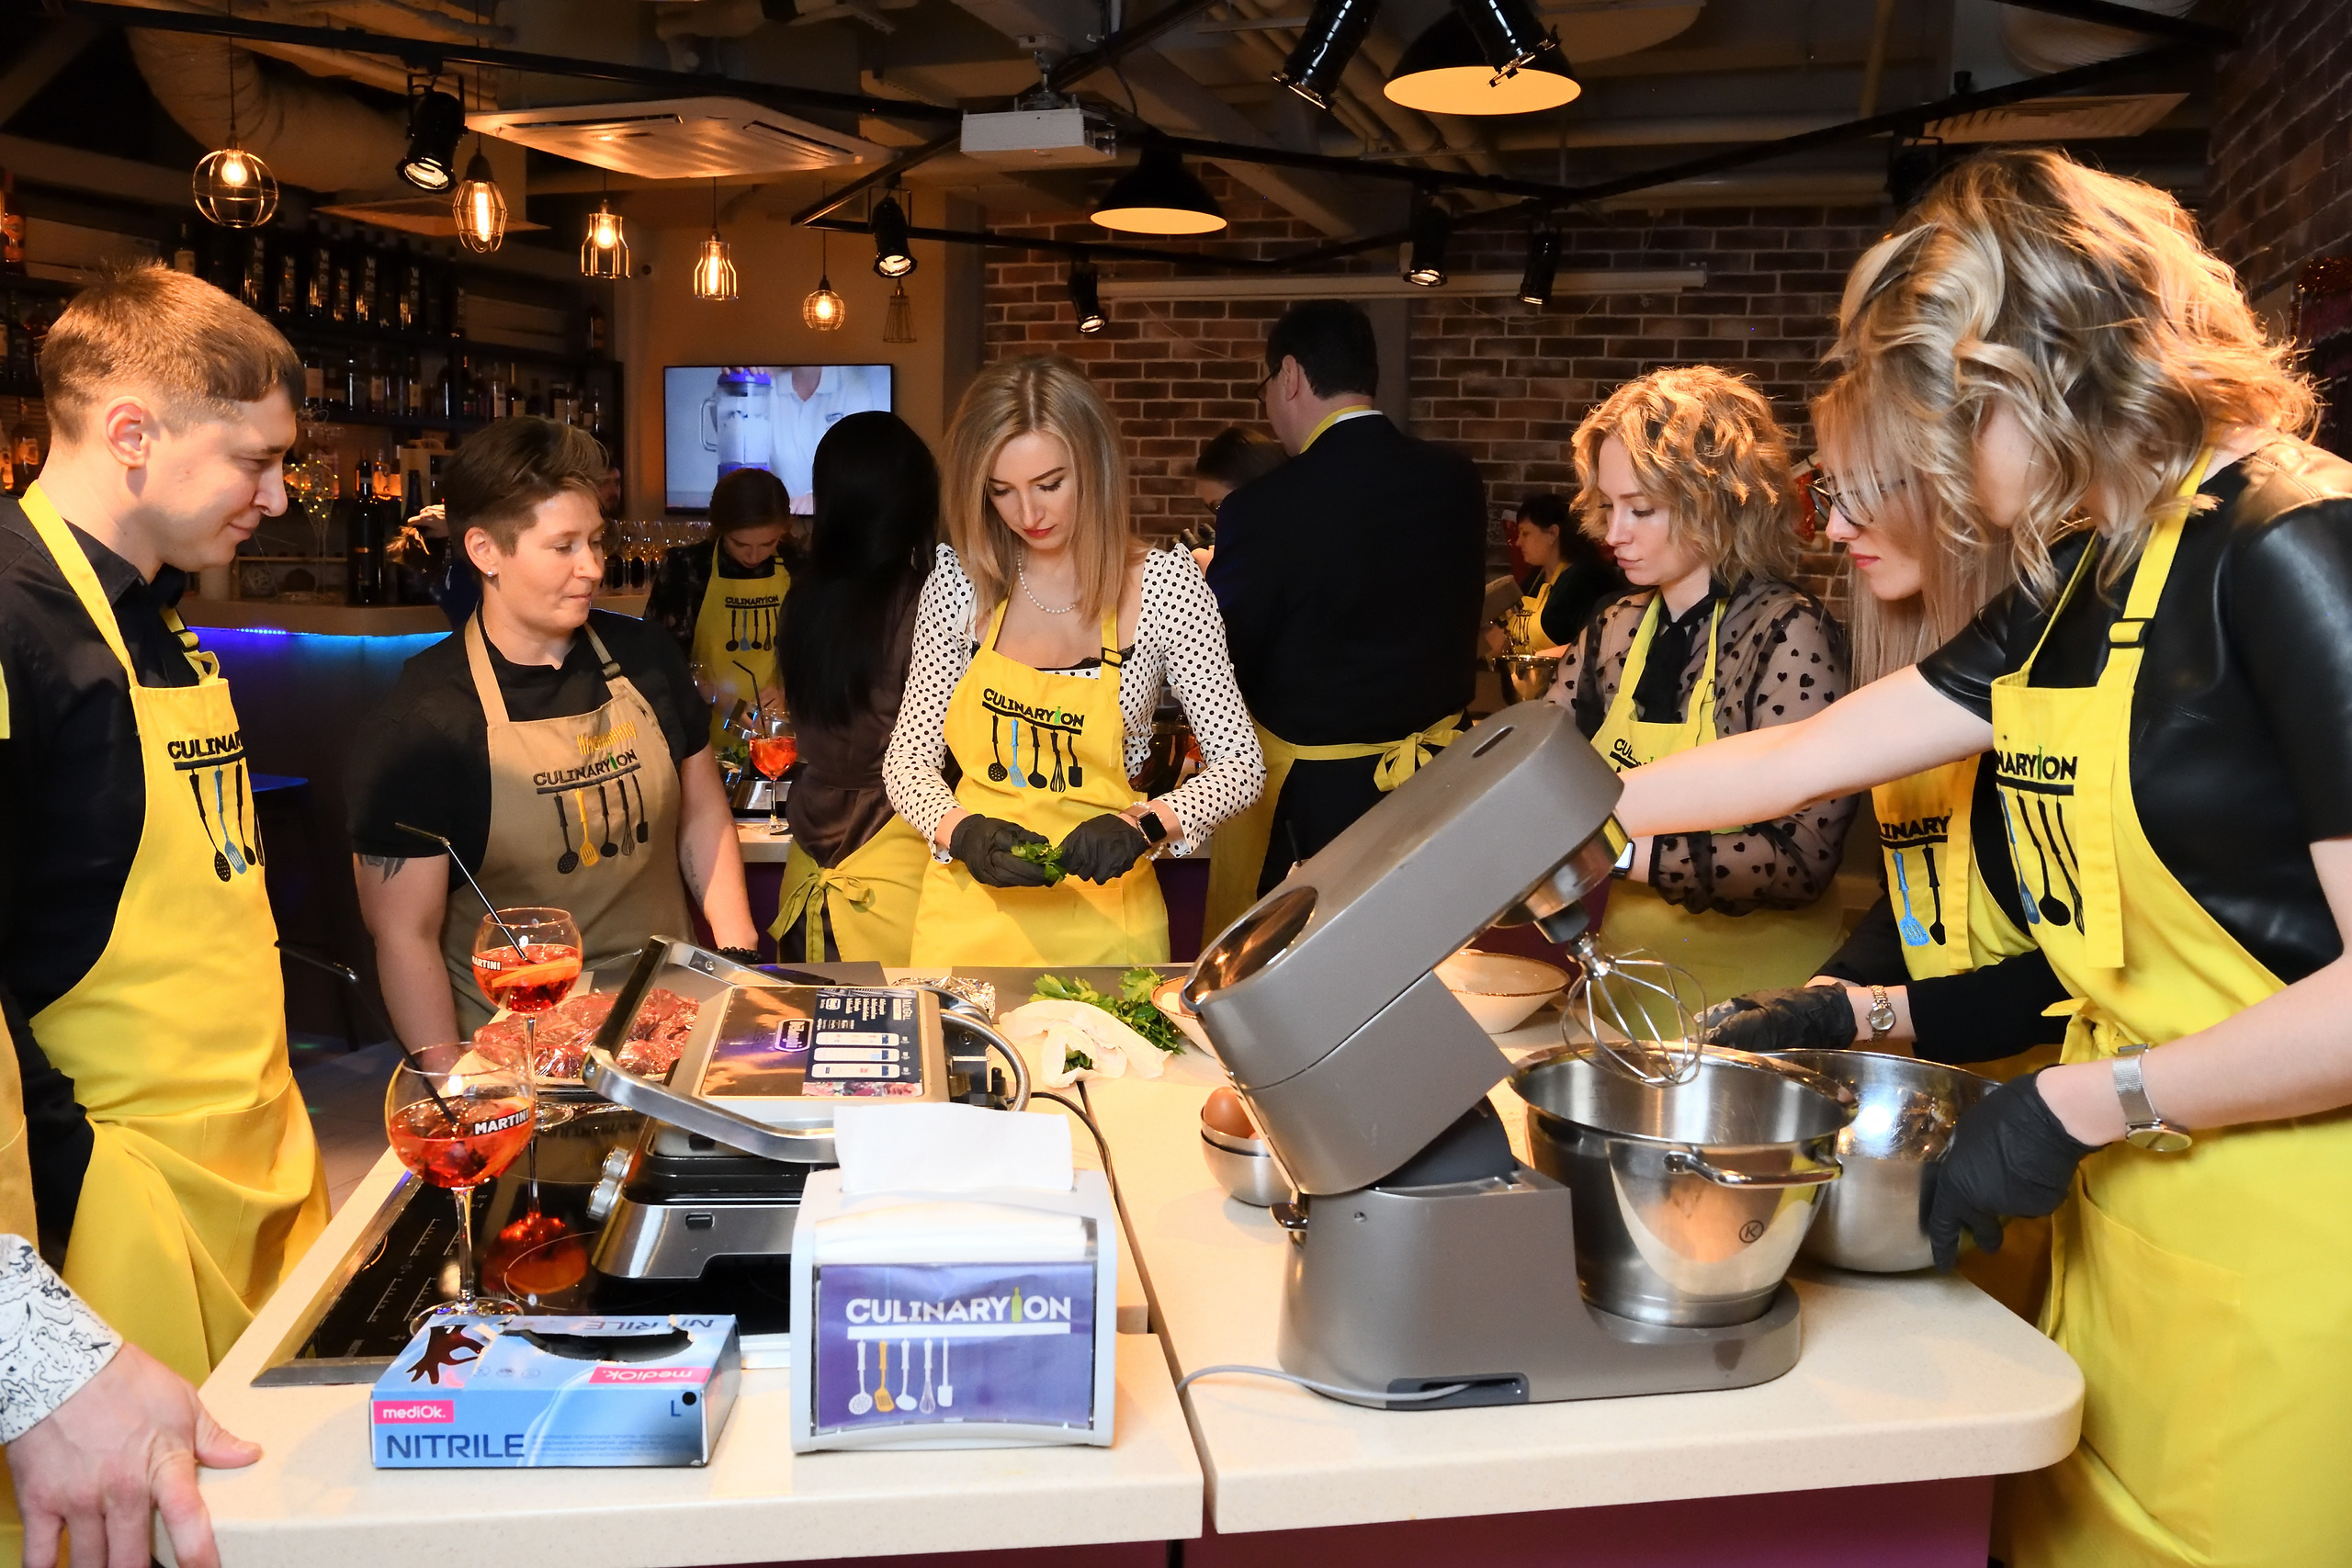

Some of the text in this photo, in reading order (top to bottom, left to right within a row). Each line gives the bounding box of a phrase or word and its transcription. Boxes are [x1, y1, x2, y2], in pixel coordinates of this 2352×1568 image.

[474, 1108, 530, 1135] MARTINI
[382, 1404, 447, 1420] mediOk.
[671, 1399, 682, 1417] L
[387, 1433, 525, 1459] NITRILE
